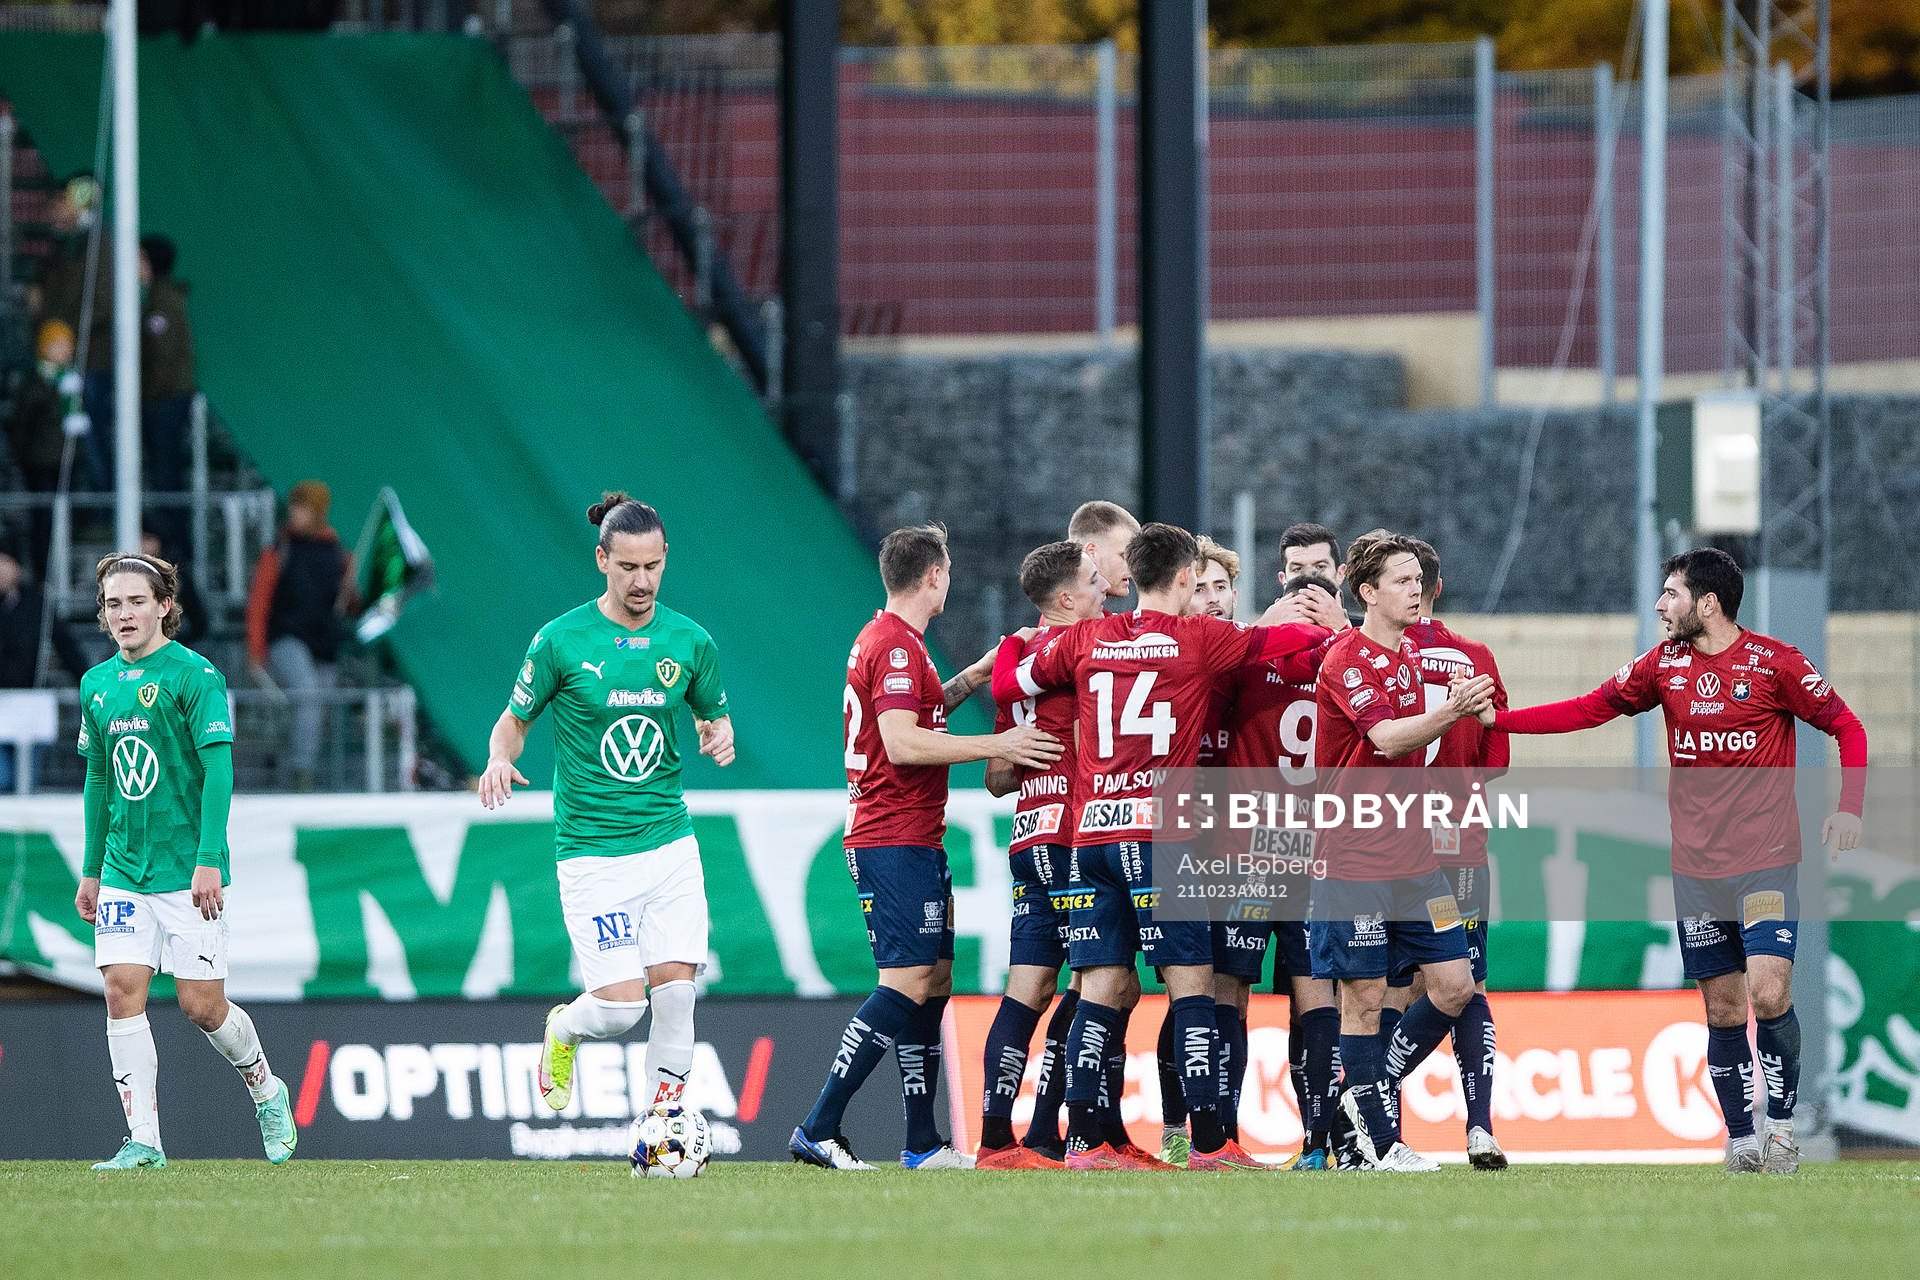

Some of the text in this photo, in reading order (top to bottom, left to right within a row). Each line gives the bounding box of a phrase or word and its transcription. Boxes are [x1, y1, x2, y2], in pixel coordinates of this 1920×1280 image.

[1744, 642, 1775, 658] BJELIN
[608, 688, 666, 706] Atteviks
[1088, 671, 1177, 760] 14
[109, 715, 150, 734] Atteviks
[1278, 699, 1318, 786] 9
[1699, 730, 1757, 752] BYGG
[1093, 769, 1167, 794] PAULSON
[1013, 810, 1040, 840] ESAB
[1082, 803, 1133, 828] BESAB
[1253, 828, 1312, 858] BESAB
[830, 1017, 872, 1080] MIKE
[897, 1044, 927, 1097] MIKE
[1077, 1020, 1108, 1072] MIKE
[1184, 1026, 1211, 1078] MIKE
[1385, 1027, 1419, 1078] MIKE
[996, 1045, 1027, 1100] MIKE
[1757, 1049, 1785, 1100] MIKE
